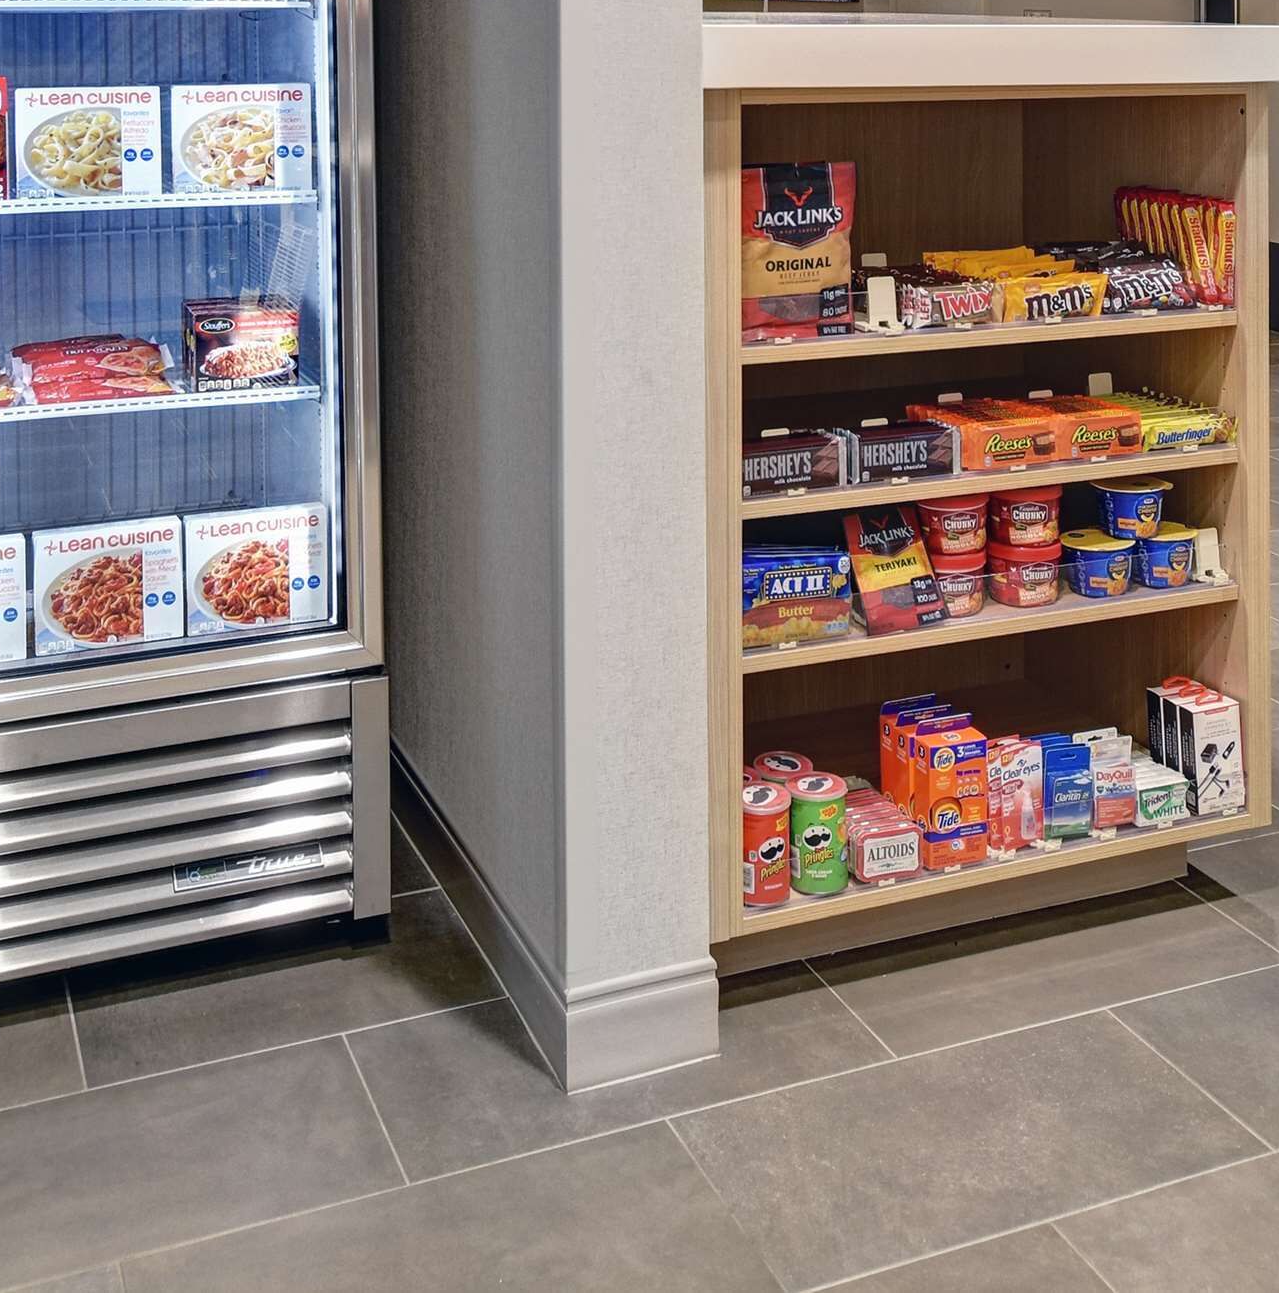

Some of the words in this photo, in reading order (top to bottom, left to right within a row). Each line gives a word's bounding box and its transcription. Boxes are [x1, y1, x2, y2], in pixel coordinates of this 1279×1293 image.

[754, 209, 796, 229] JACK
[797, 204, 843, 225] LINK'S
[765, 255, 832, 273] ORIGINAL
[823, 290, 835, 301] 11g
[920, 288, 932, 321] LEFT
[822, 307, 834, 317] 80
[1071, 423, 1118, 445] Reese's
[1156, 426, 1213, 446] Butterfinger
[984, 433, 1034, 454] Reese's
[863, 439, 928, 467] HERSHEY'S
[744, 450, 812, 482] HERSHEY'S
[1012, 509, 1047, 521] CHUNKY
[944, 519, 977, 531] CHUNKY
[858, 532, 884, 548] JACK
[883, 525, 915, 541] LINK'S
[874, 555, 918, 573] TERIYAKI
[1022, 569, 1052, 581] CHUNKY
[770, 576, 804, 595] ACT
[806, 574, 825, 592] II
[939, 580, 973, 593] CHUNKY
[778, 605, 814, 620] Butter
[936, 752, 954, 767] Tide
[957, 746, 965, 757] 3
[1002, 768, 1023, 781] Clear
[1023, 762, 1041, 776] eyes
[1095, 769, 1133, 783] DayQuil
[1055, 792, 1082, 804] Claritin
[1143, 790, 1171, 807] Trident
[937, 811, 960, 829] Tide
[1152, 805, 1185, 819] WHITE
[804, 847, 834, 867] Pringles
[867, 842, 915, 862] ALTOIDS
